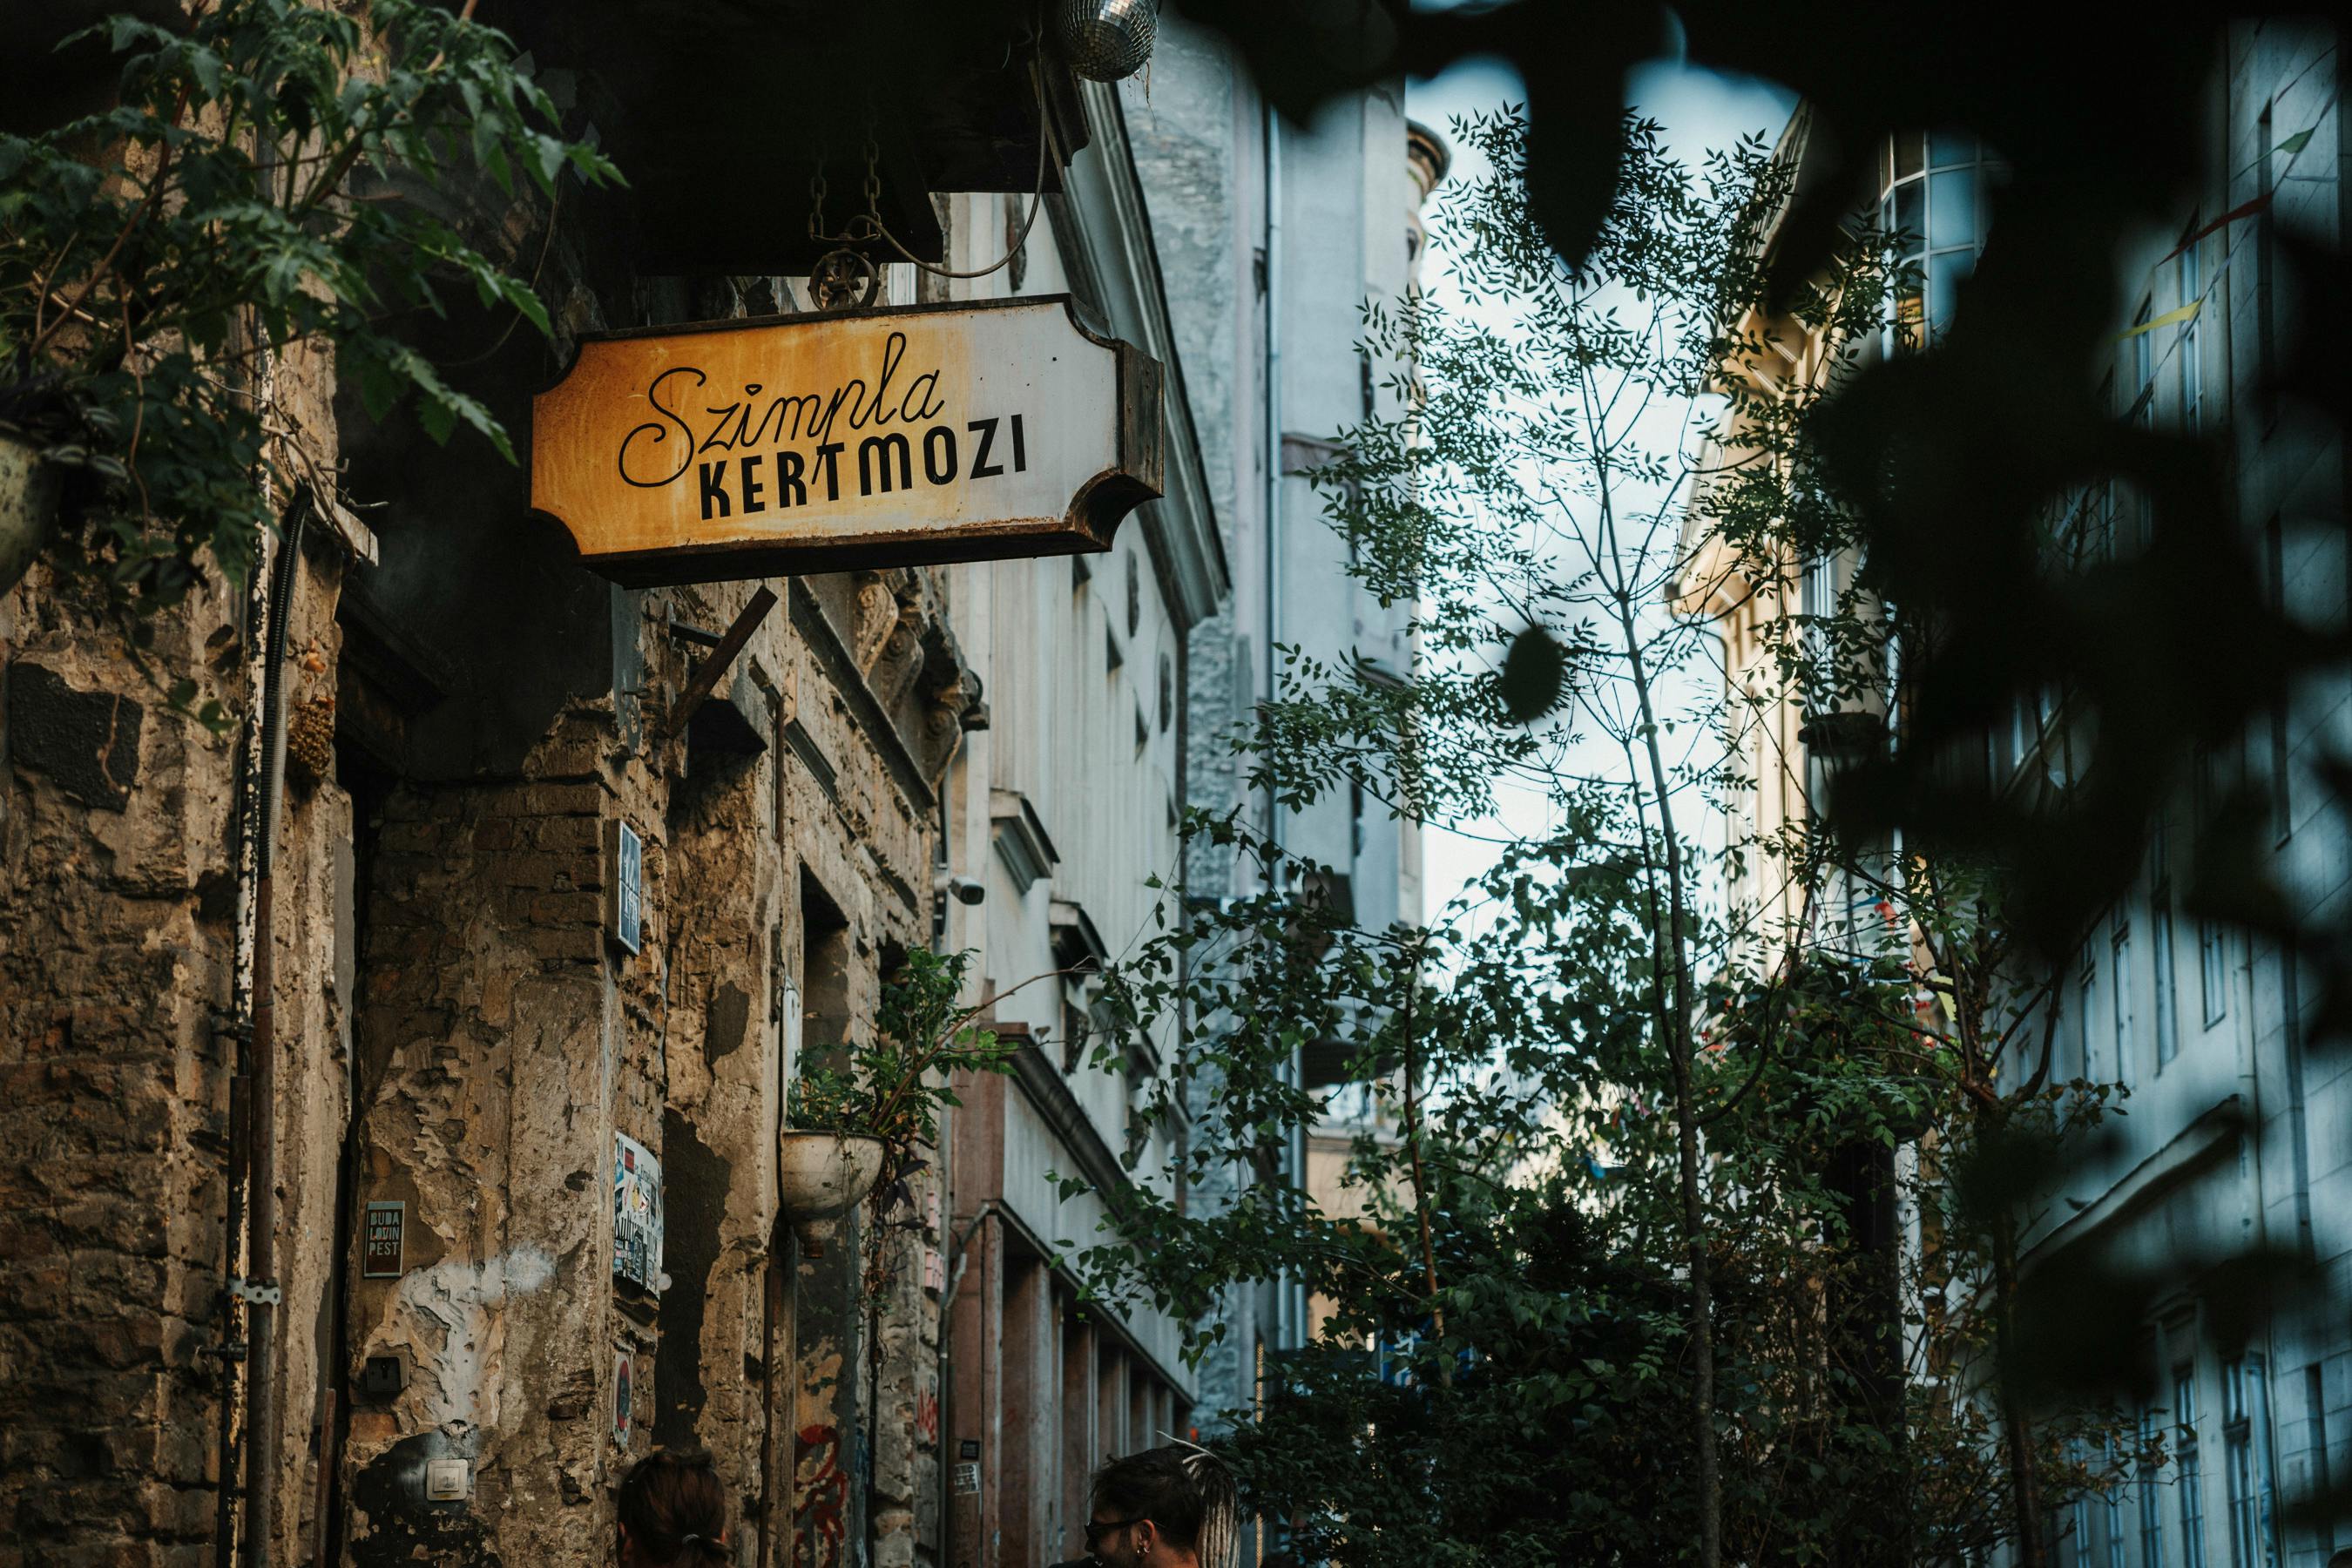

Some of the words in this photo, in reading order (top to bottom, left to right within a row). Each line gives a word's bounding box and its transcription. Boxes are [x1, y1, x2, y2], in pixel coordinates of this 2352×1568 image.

[618, 332, 945, 488] Szimpla
[700, 414, 1027, 521] KERTMOZI
[368, 1241, 399, 1255] PEST
[370, 1212, 400, 1226] BUDA
